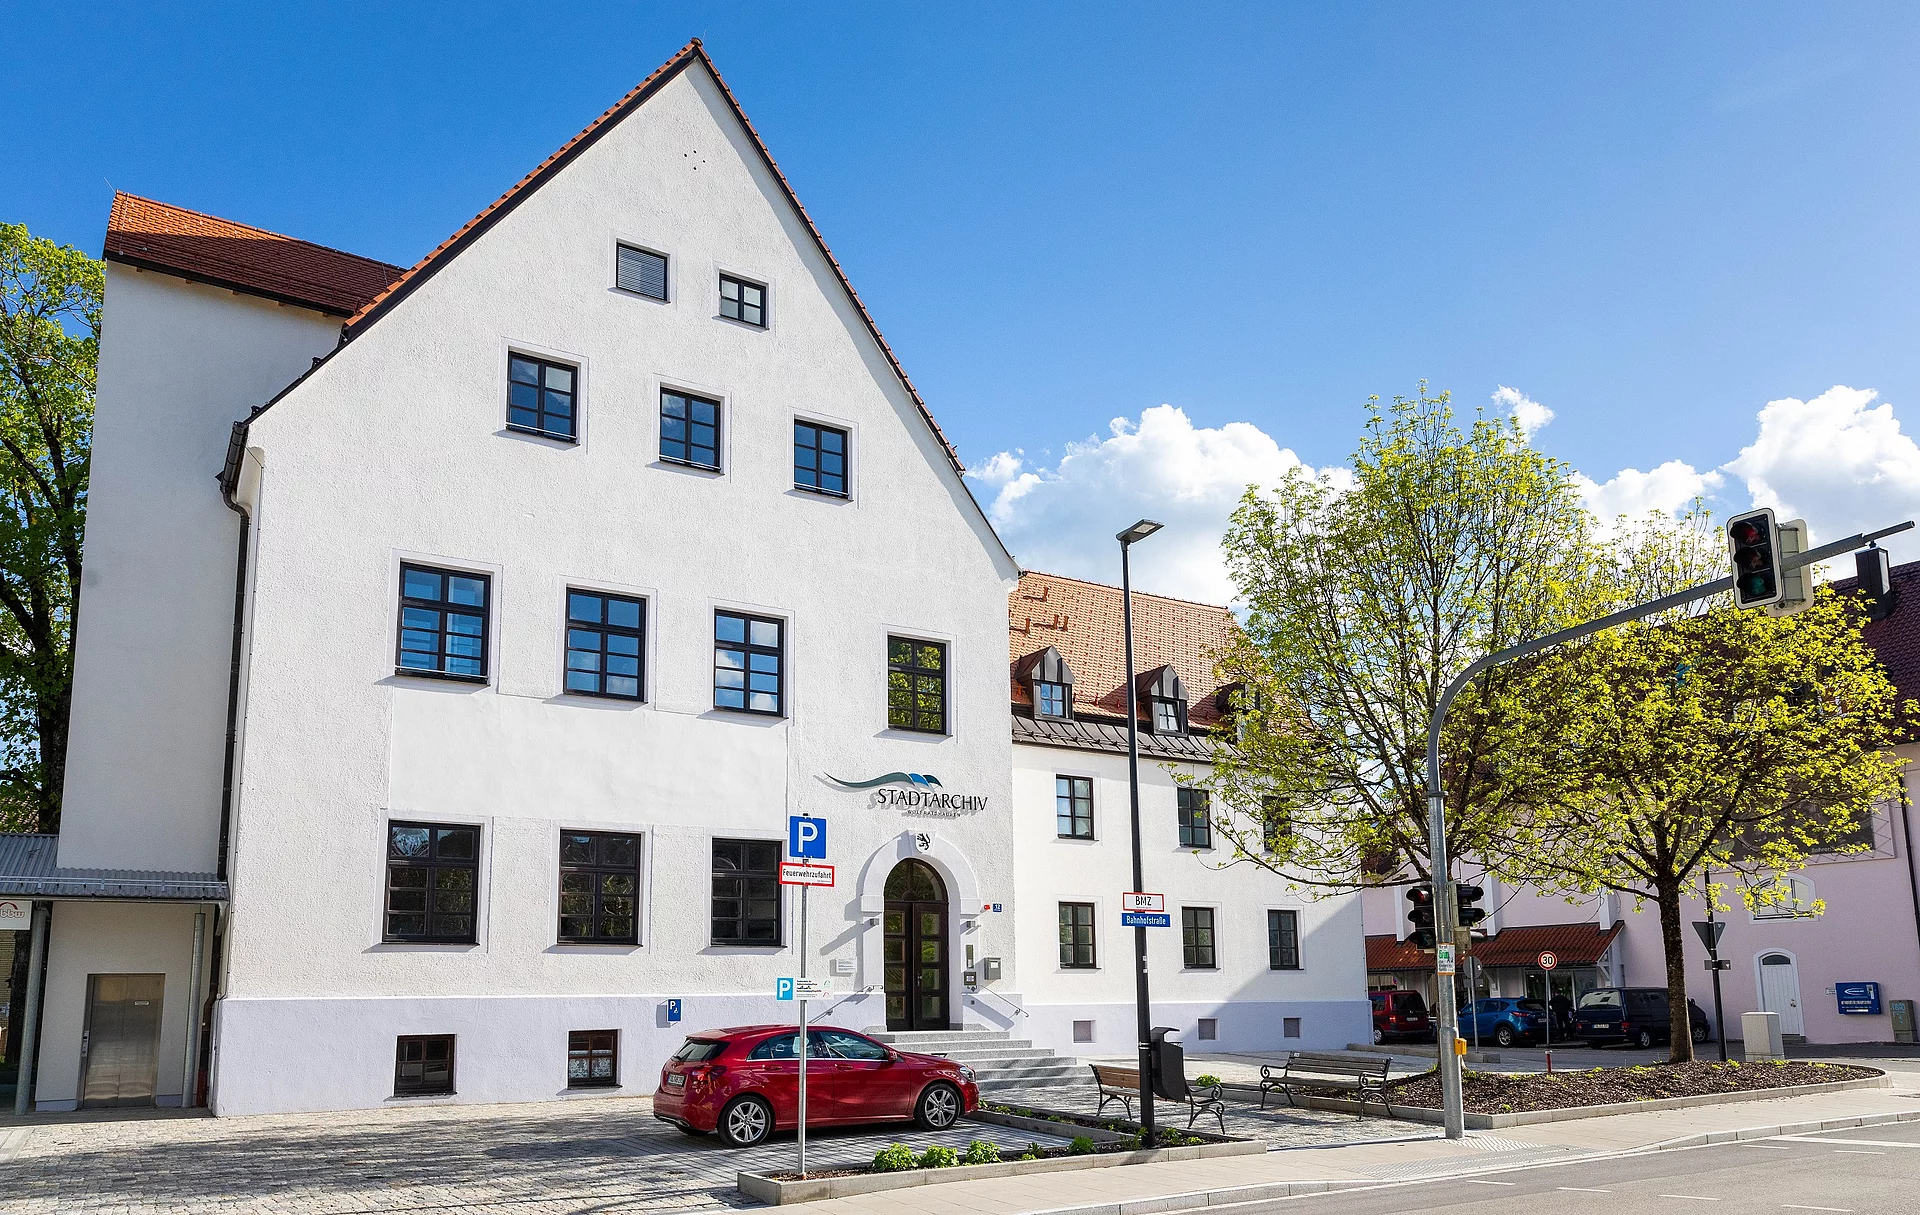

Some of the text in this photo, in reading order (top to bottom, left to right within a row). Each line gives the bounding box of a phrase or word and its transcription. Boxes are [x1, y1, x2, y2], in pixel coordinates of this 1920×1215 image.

[877, 788, 988, 811] STADTARCHIV
[797, 821, 818, 853] P
[782, 868, 832, 879] Feuerwehrzufahrt
[1135, 895, 1152, 906] BMZ
[1126, 915, 1166, 925] Bahnhofstraße
[1542, 955, 1553, 965] 30
[778, 979, 791, 999] P
[670, 1000, 677, 1010] P
